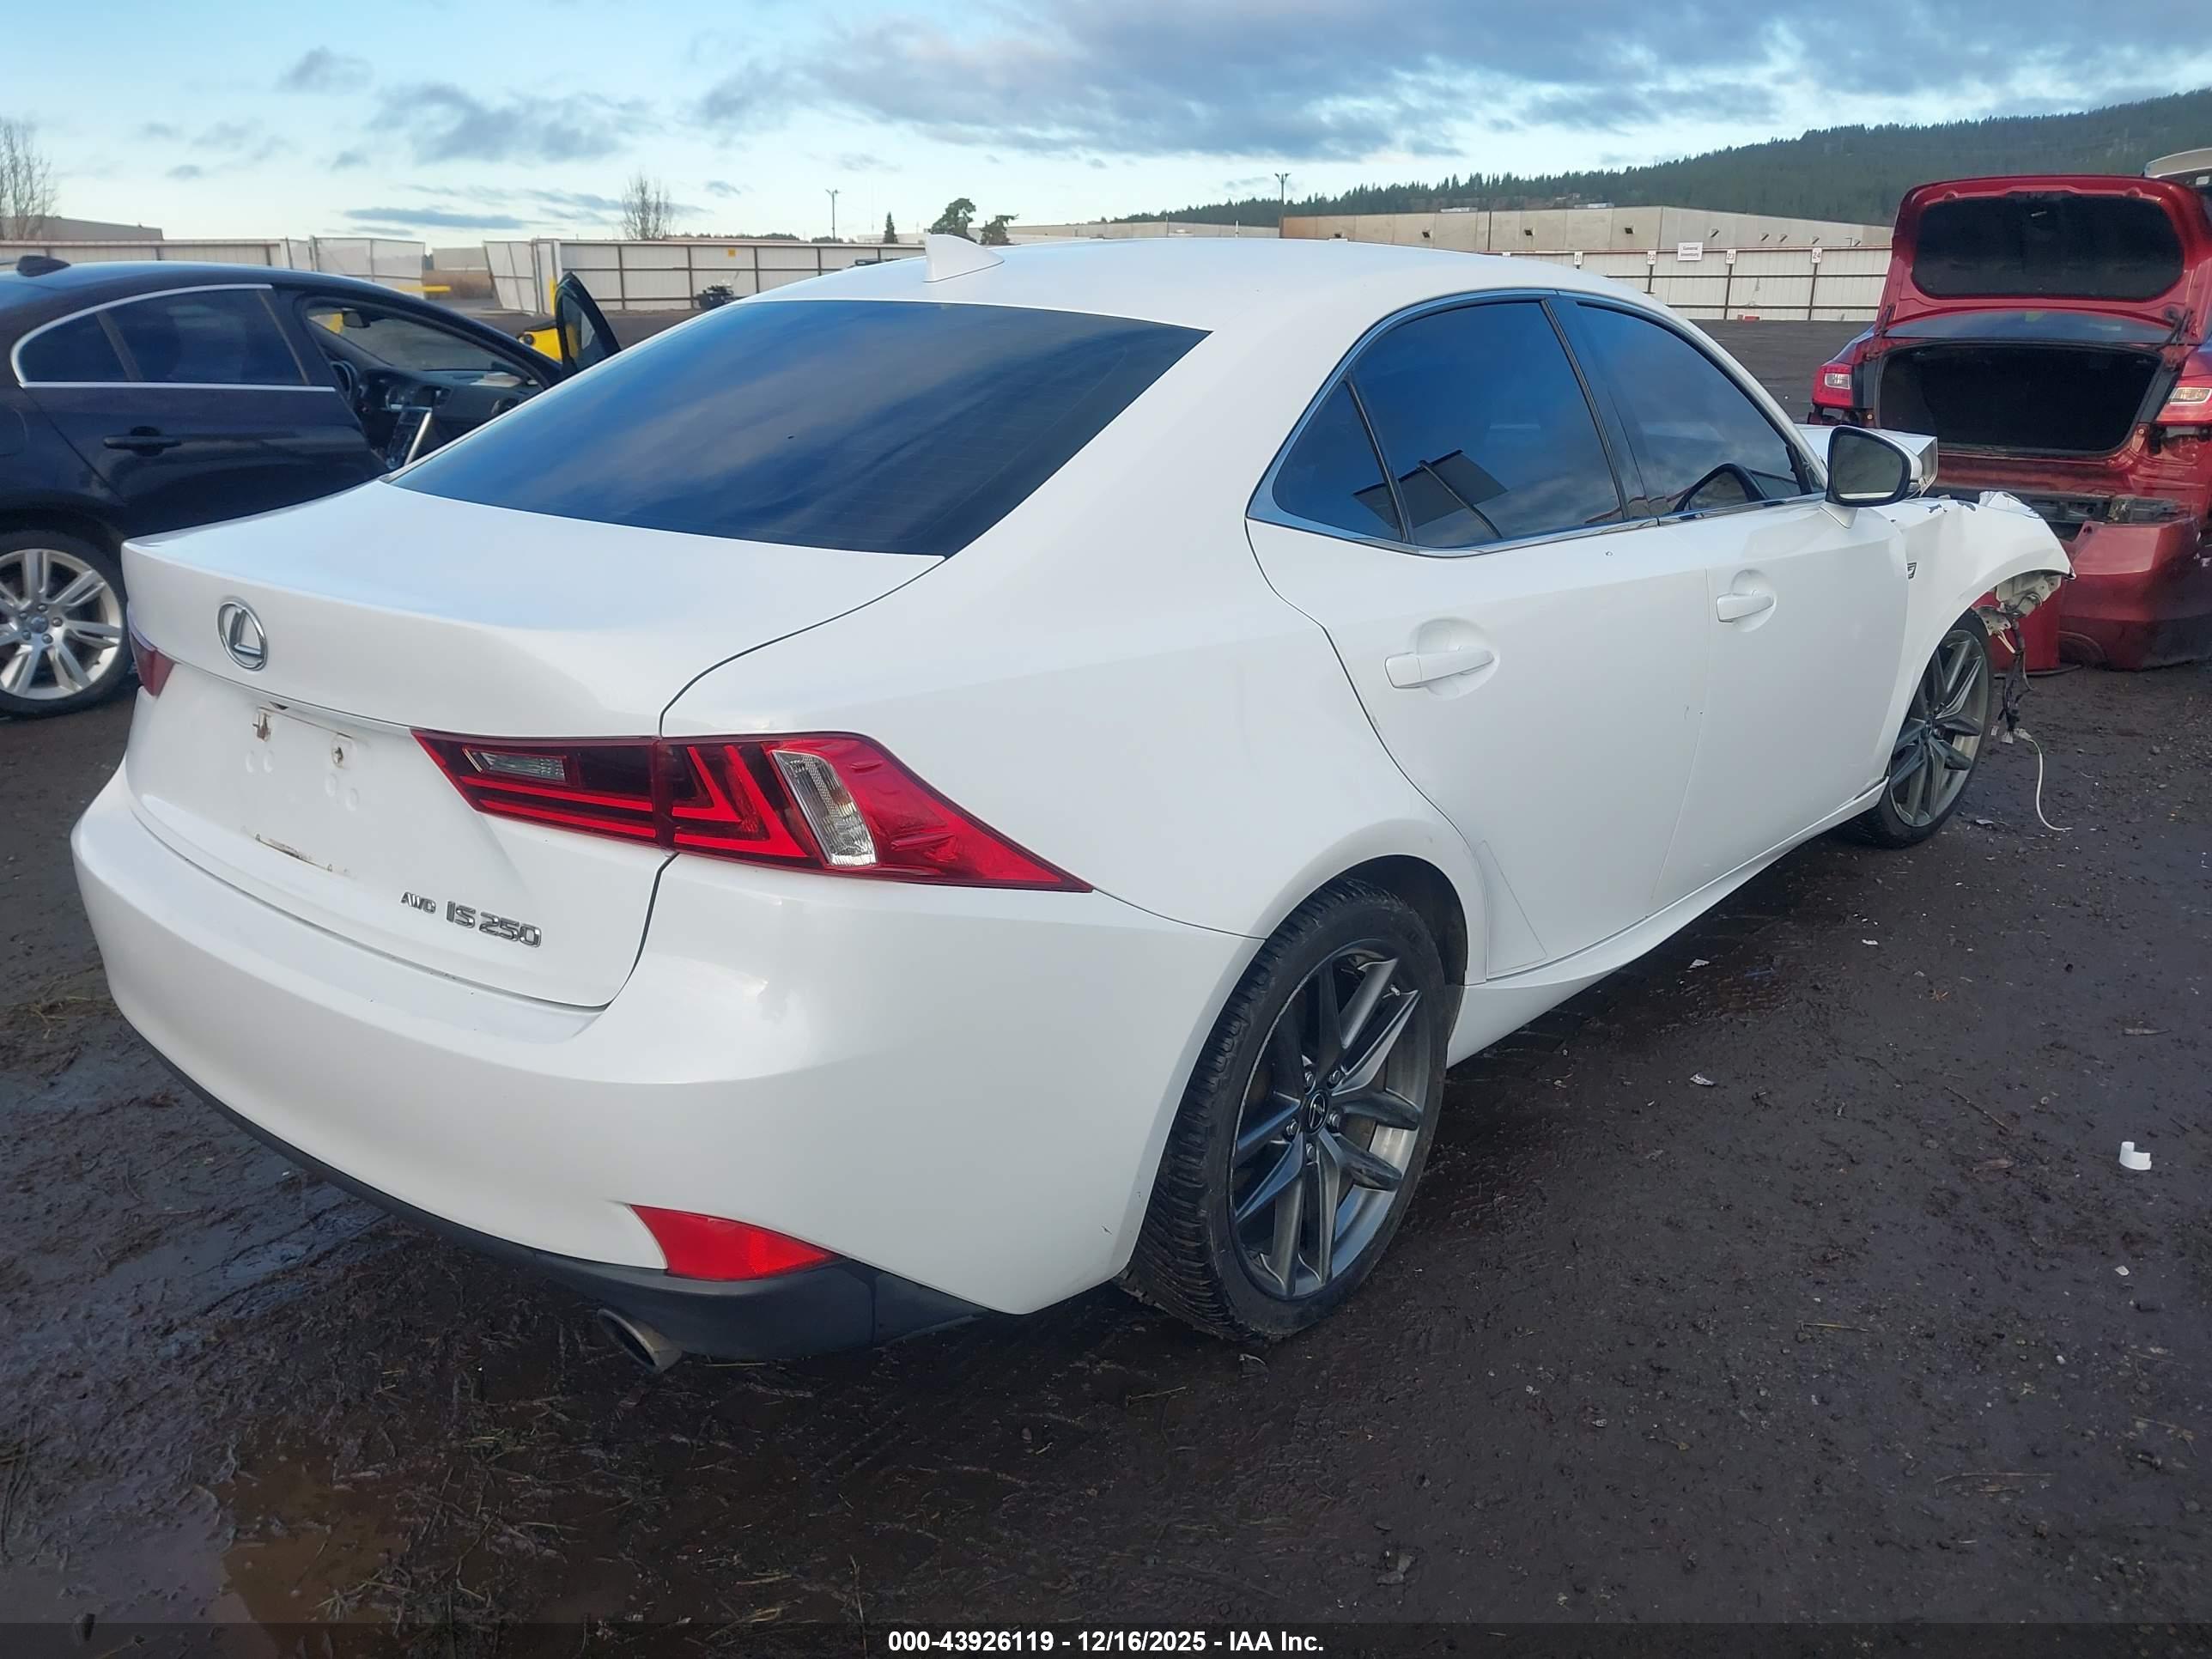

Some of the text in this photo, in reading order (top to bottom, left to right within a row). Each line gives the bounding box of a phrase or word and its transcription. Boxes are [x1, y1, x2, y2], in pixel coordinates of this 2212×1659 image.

[400, 891, 542, 947] AWD IS 250
